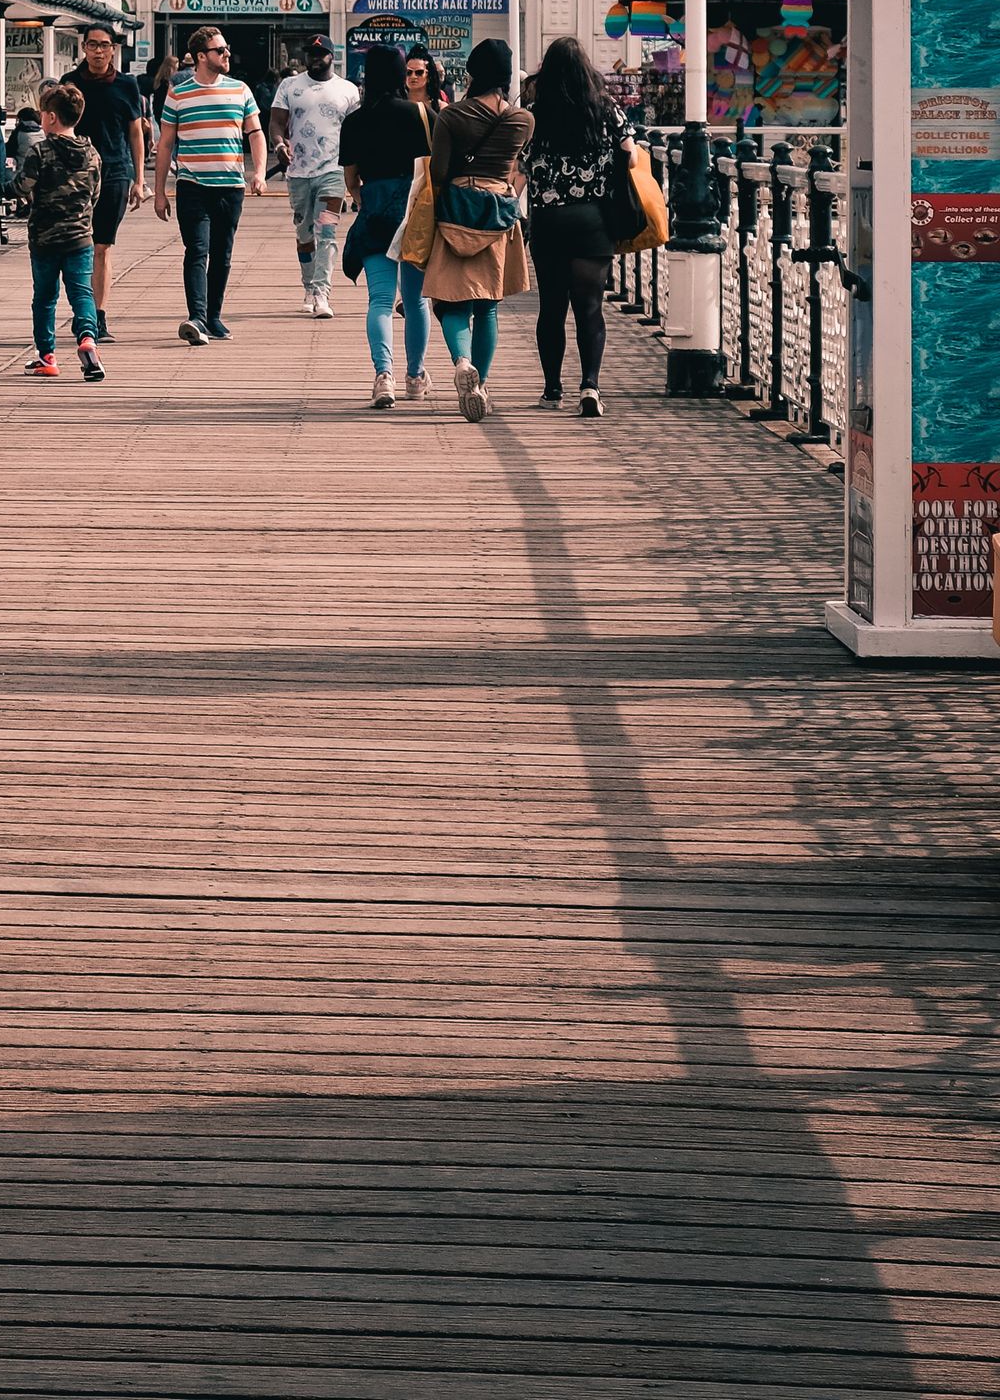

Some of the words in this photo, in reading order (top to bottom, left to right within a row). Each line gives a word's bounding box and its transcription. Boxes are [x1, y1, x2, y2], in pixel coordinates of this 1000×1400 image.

[367, 0, 399, 10] WHERE
[402, 0, 439, 10] TICKETS
[442, 0, 469, 10] MAKE
[472, 0, 503, 10] PRIZES
[420, 17, 436, 26] AND
[438, 15, 453, 23] TRY
[454, 15, 471, 25] OUR
[424, 25, 468, 37] MPTION
[5, 34, 39, 48] REAM
[353, 32, 382, 42] WALK
[384, 32, 391, 43] of
[393, 32, 422, 42] FAME
[428, 38, 461, 49] HINES
[446, 68, 469, 76] KETS
[917, 94, 990, 111] BRIGHTON
[911, 109, 960, 120] PALACE
[965, 109, 998, 120] PIER
[915, 131, 991, 140] COLLECTIBLE
[916, 146, 988, 155] MEDALLIONS
[944, 215, 973, 223] Collect
[975, 215, 987, 223] all
[989, 215, 998, 223] 4!
[912, 500, 955, 518] LOOK
[963, 500, 998, 518] FOR
[923, 518, 983, 536] OTHER
[917, 536, 990, 555] DESIGNS
[920, 555, 939, 573] AT
[947, 555, 988, 573] THIS
